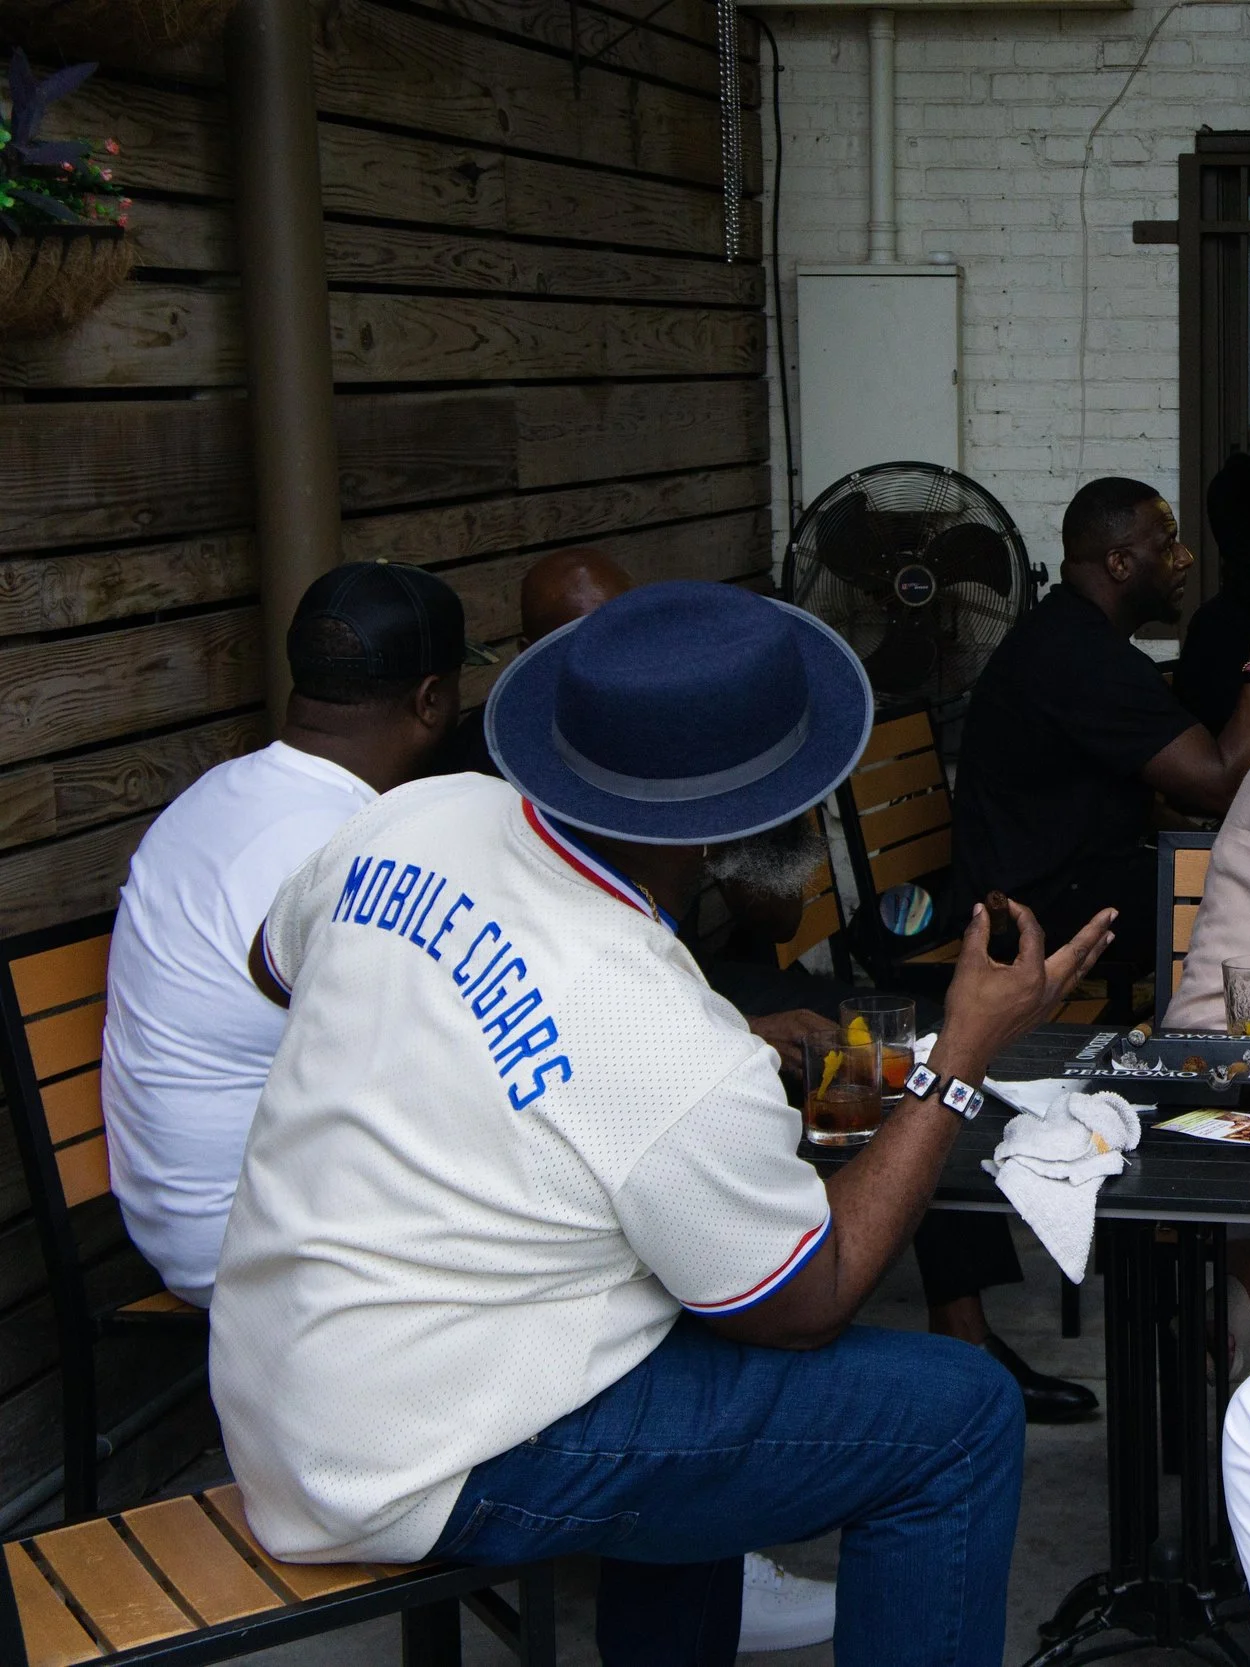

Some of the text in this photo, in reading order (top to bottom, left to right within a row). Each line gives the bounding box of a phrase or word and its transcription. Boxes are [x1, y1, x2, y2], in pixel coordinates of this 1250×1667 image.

[332, 856, 572, 1111] MOBILE CIGARS
[1062, 1069, 1198, 1078] PERDOMO
